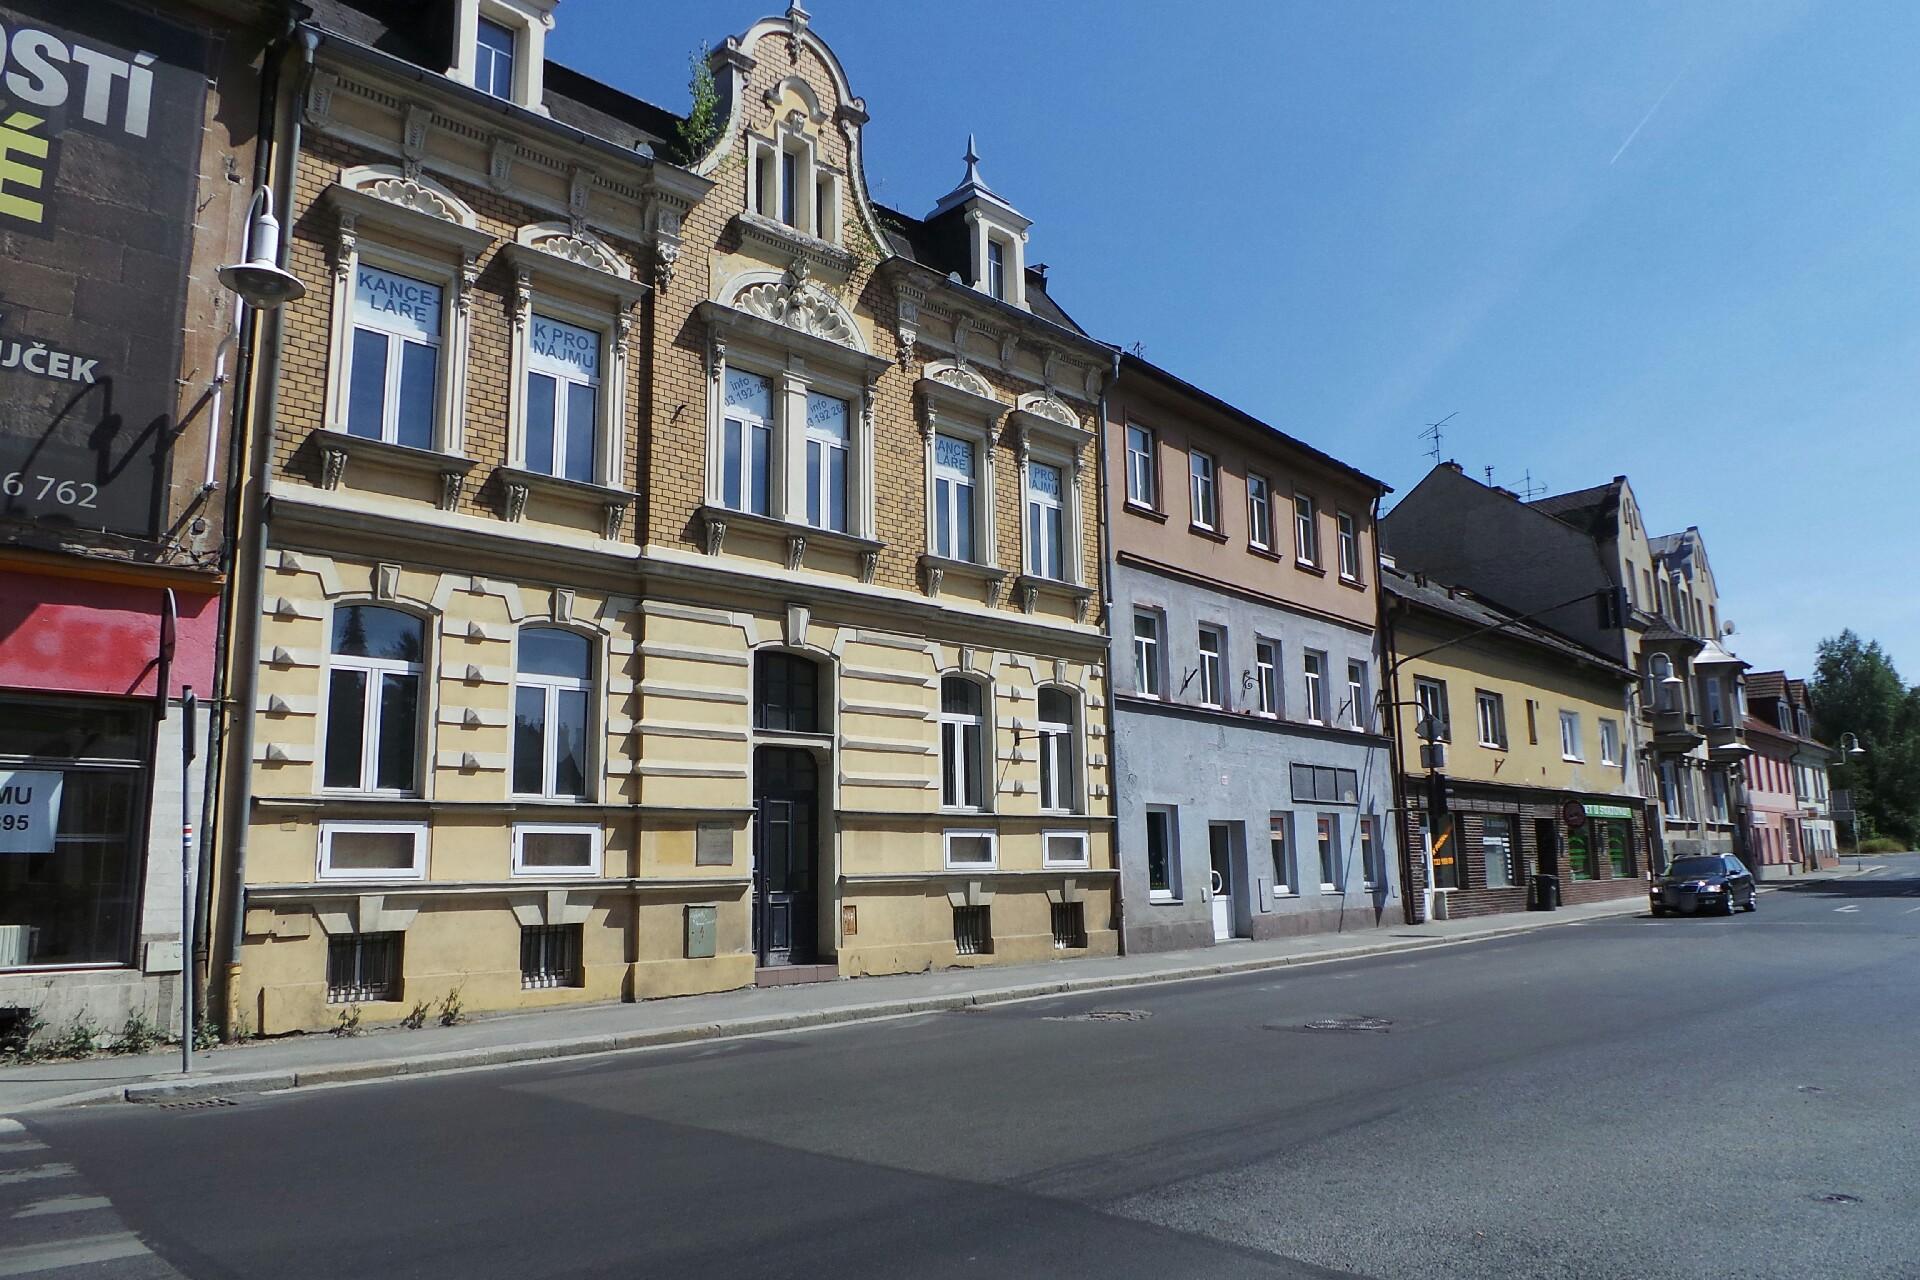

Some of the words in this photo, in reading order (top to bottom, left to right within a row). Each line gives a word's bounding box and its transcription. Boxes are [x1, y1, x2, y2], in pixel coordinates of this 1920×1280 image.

[0, 23, 158, 138] STÍ
[359, 273, 439, 306] KANCE-
[371, 294, 426, 323] LÁŘE
[535, 323, 546, 339] K
[553, 328, 595, 351] PRO-
[0, 337, 98, 384] JČEK
[534, 340, 593, 368] NÁJMU
[730, 376, 750, 392] info
[736, 387, 754, 401] 192
[810, 400, 827, 413] info
[814, 409, 830, 424] 192
[935, 438, 972, 458] ANCE-
[36, 475, 98, 509] 762
[0, 814, 29, 831] 95
